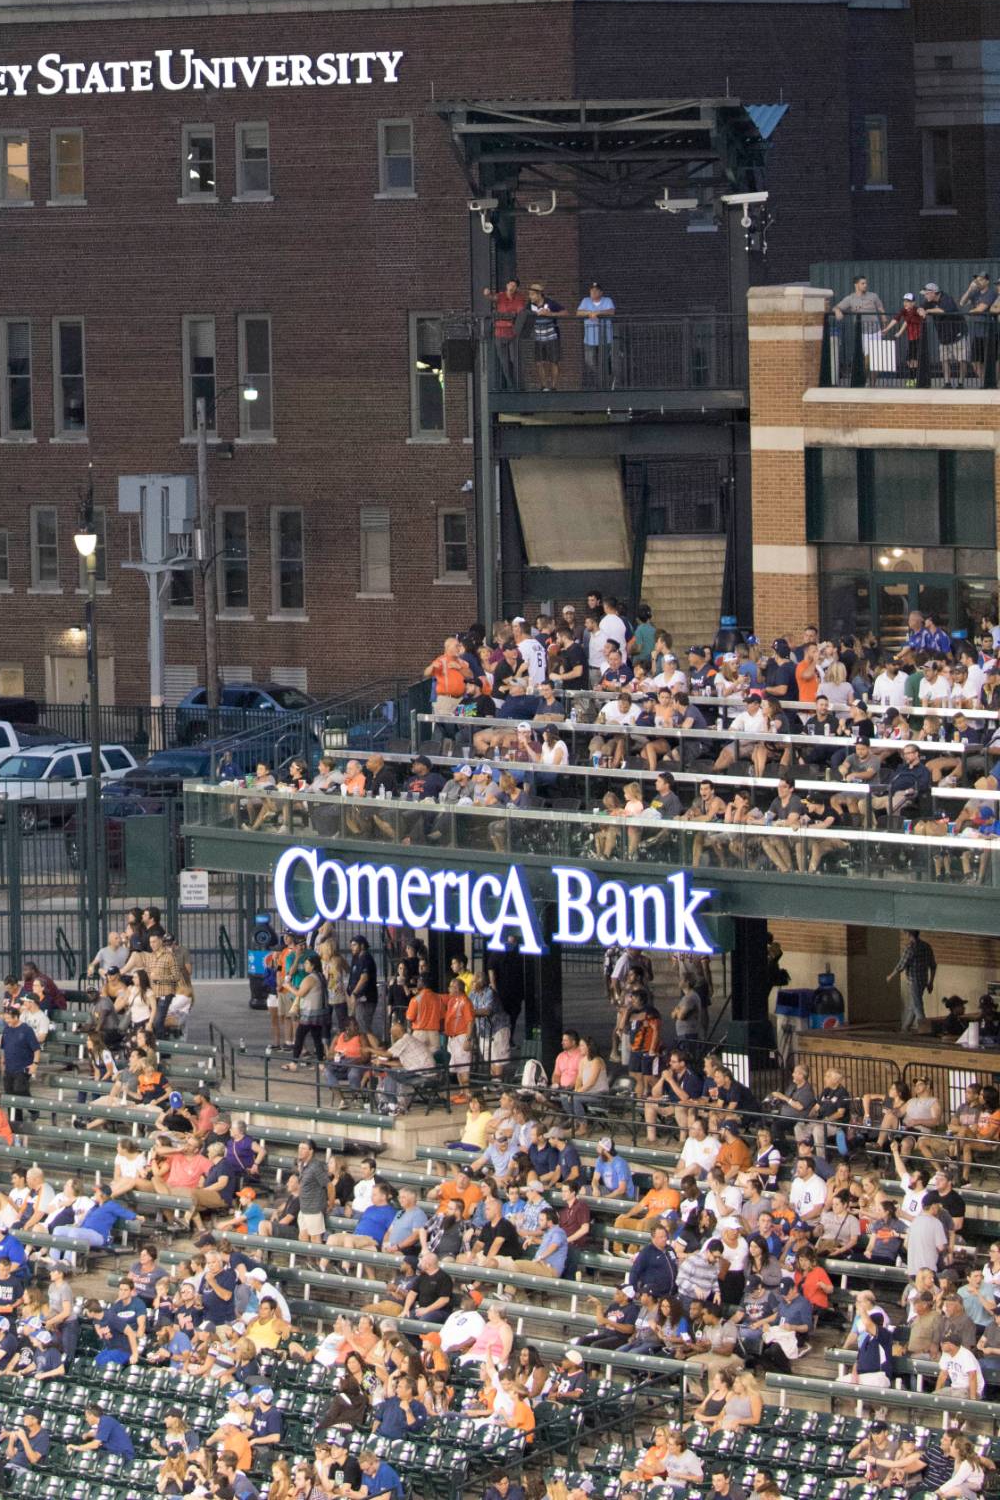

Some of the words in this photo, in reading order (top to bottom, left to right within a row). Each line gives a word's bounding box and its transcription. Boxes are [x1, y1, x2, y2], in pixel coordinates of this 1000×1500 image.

[36, 53, 154, 96] STATE
[154, 49, 403, 91] UNIVERSITY
[552, 864, 716, 955] Bank
